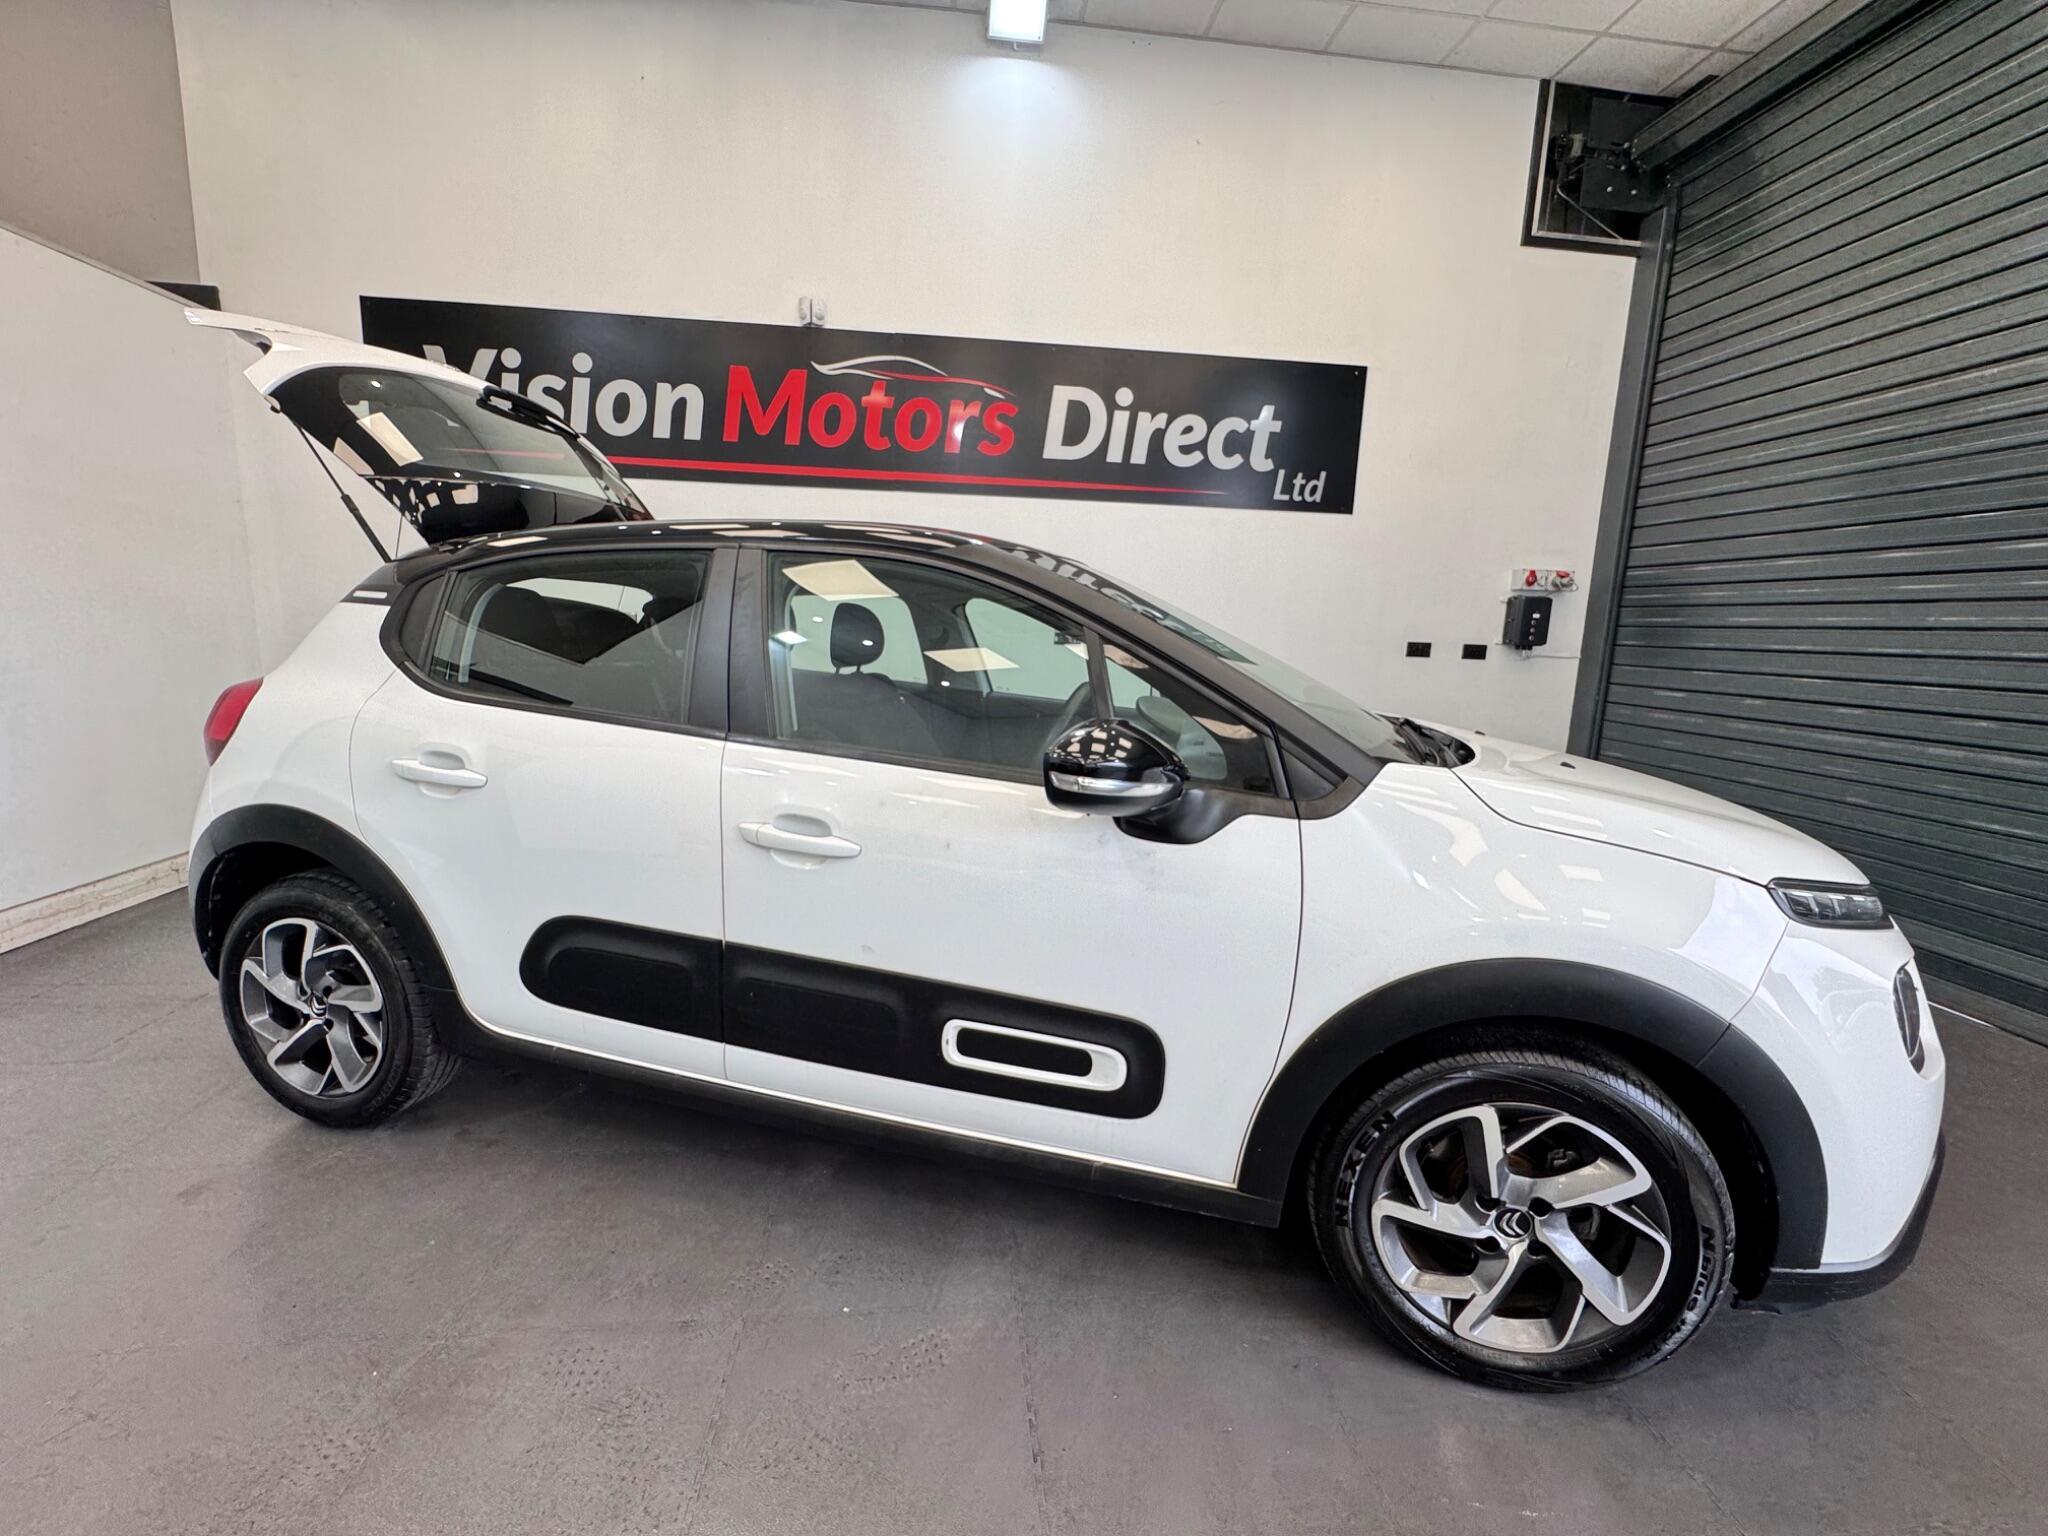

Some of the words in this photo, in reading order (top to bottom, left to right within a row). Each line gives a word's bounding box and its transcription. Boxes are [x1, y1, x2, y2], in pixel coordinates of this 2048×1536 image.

[722, 364, 1019, 456] Motors
[1042, 385, 1282, 472] Direct
[1273, 469, 1327, 503] Ltd
[1334, 1109, 1397, 1227] NEXEN
